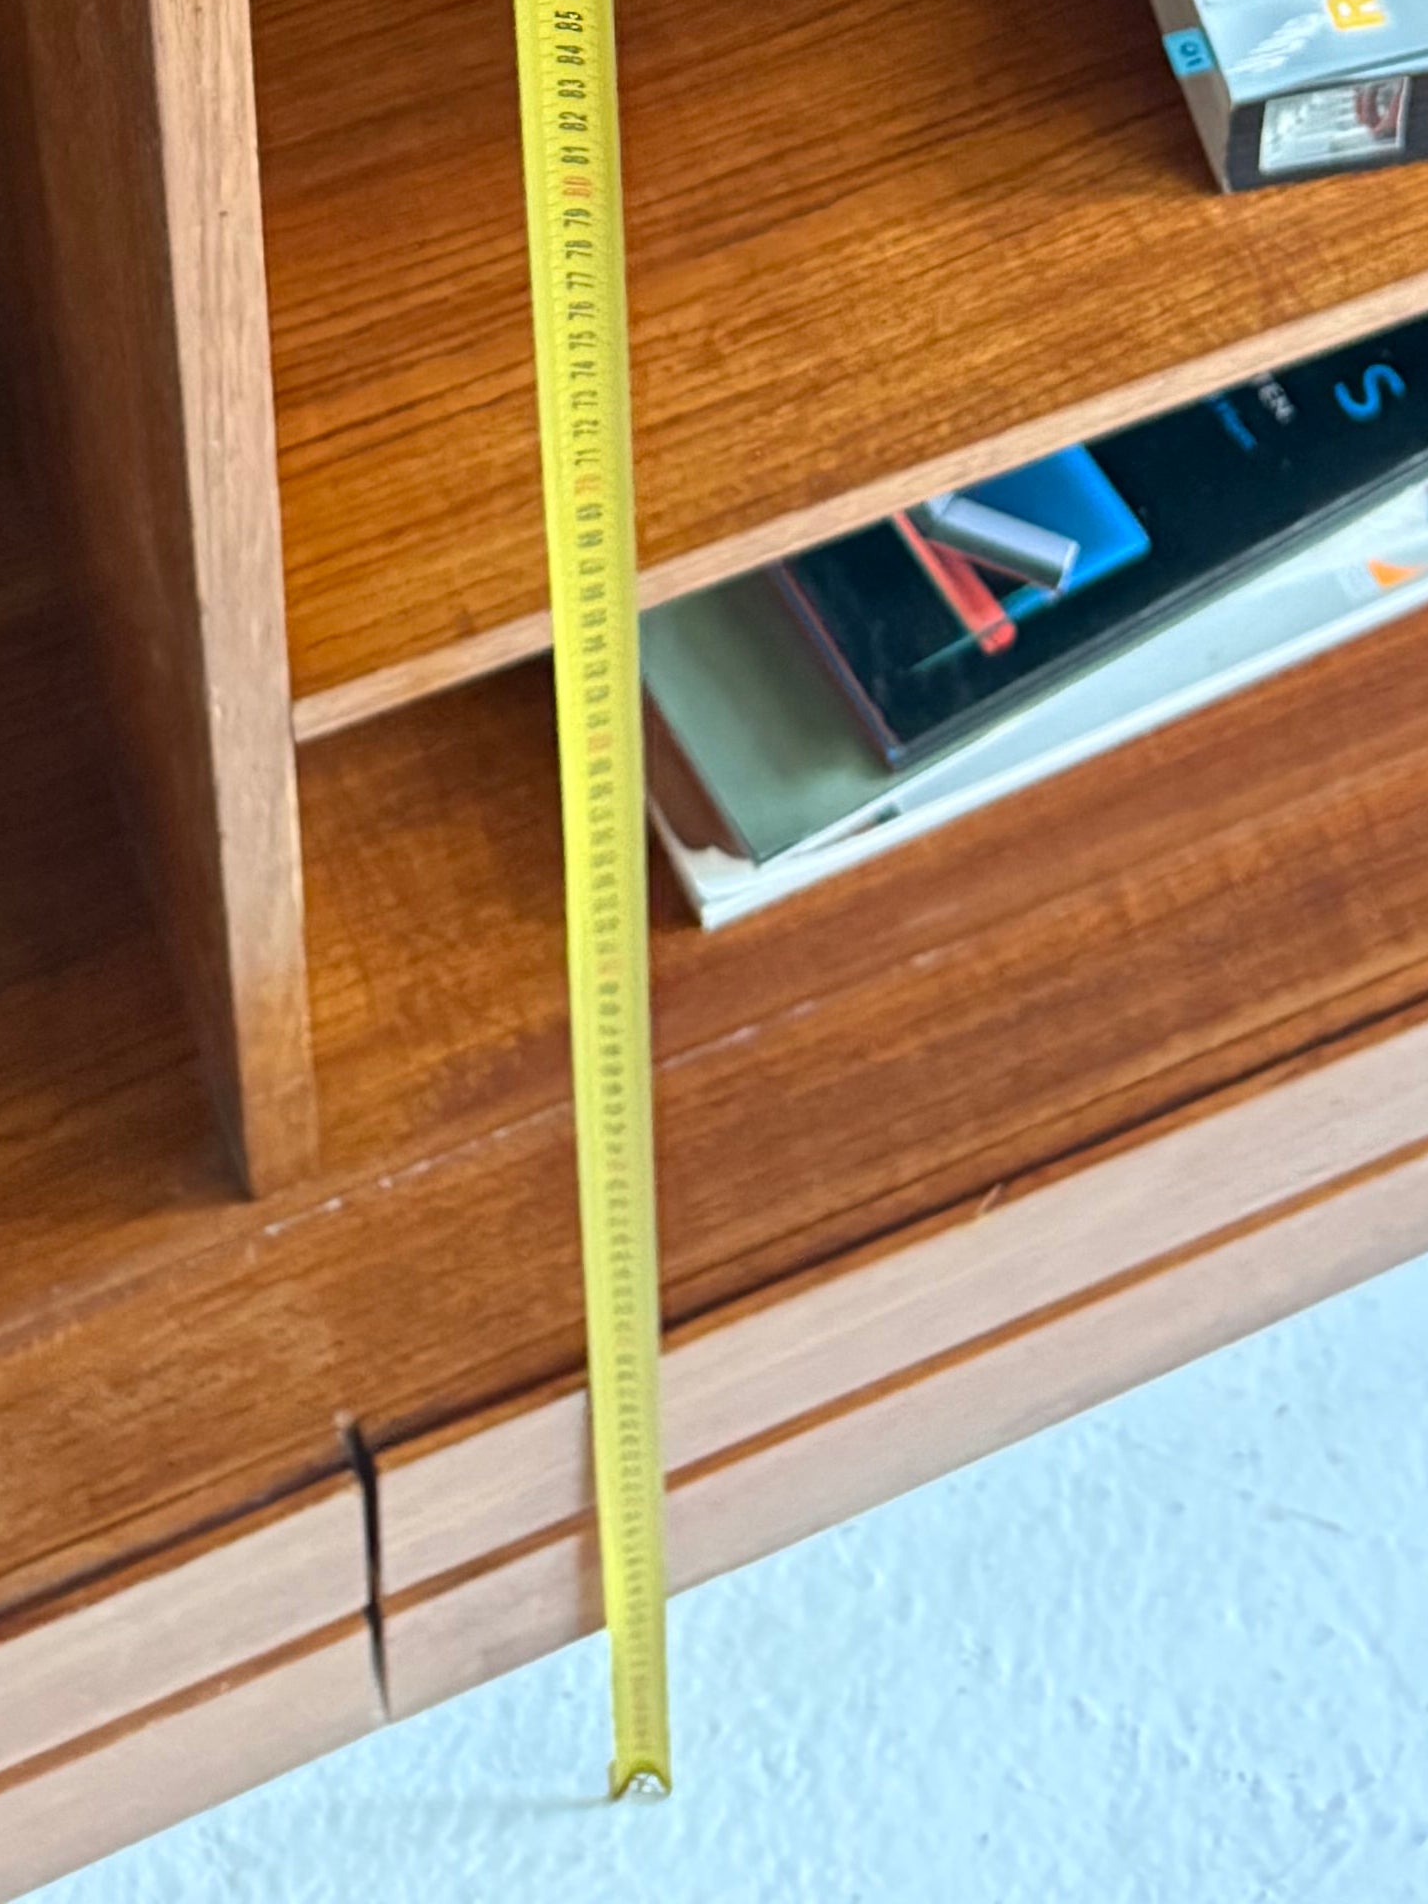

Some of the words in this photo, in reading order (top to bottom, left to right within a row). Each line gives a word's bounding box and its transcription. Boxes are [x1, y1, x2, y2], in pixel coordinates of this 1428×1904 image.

[554, 9, 582, 34] 85
[555, 43, 584, 68] 84
[557, 77, 585, 102] 83
[558, 110, 586, 134] 82
[560, 144, 588, 167] 81
[563, 207, 590, 229] 79
